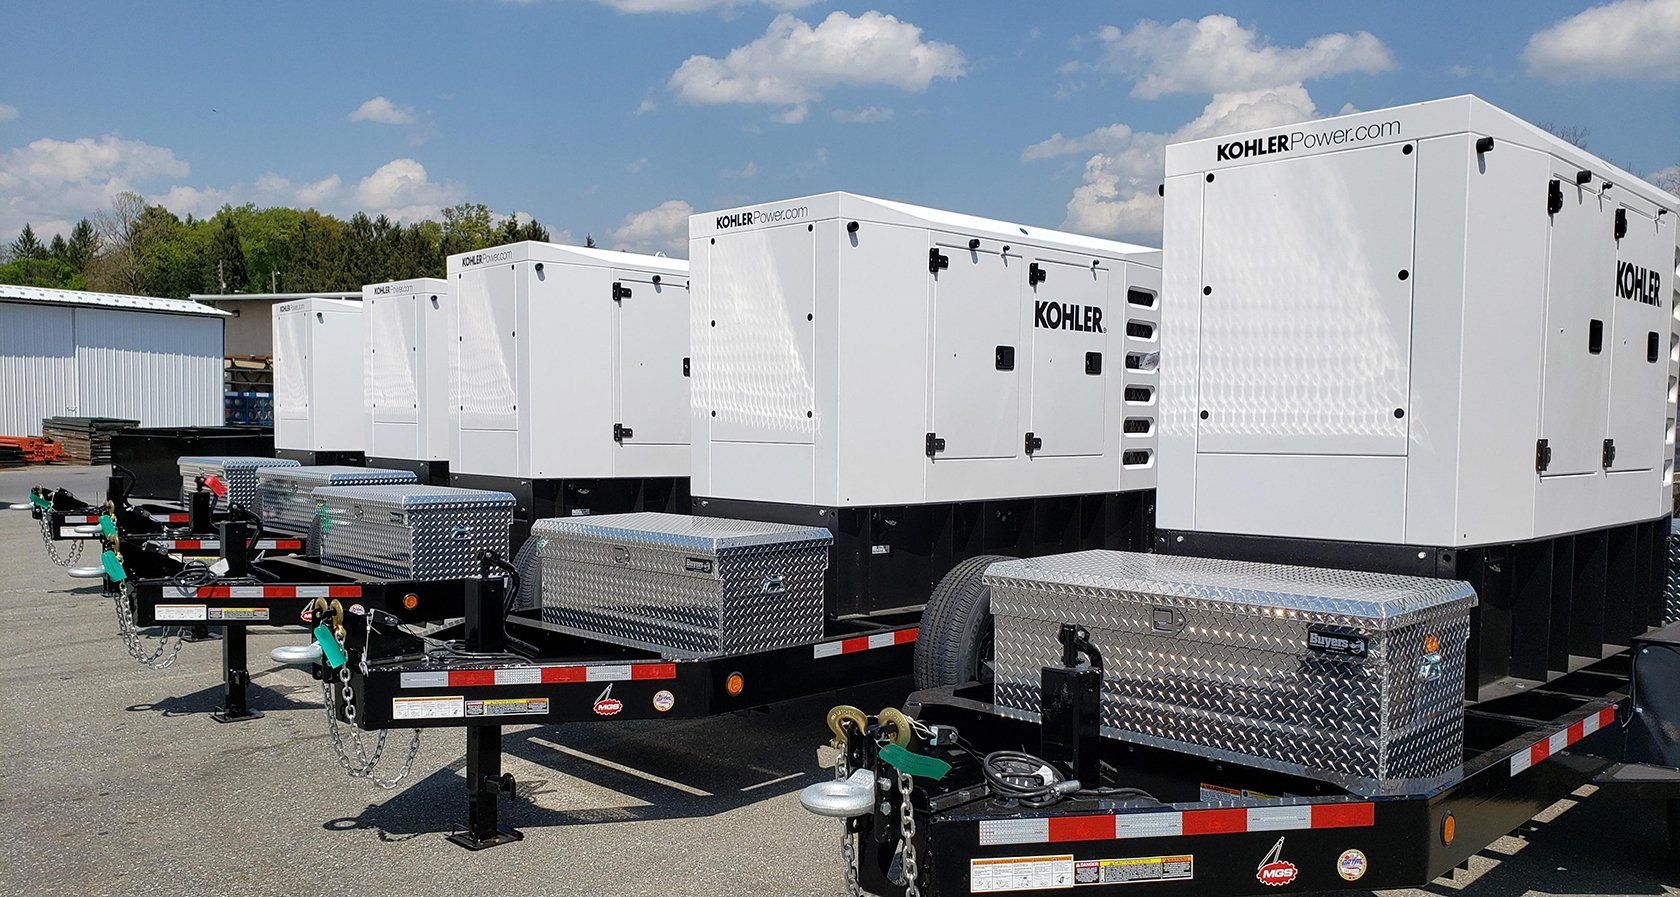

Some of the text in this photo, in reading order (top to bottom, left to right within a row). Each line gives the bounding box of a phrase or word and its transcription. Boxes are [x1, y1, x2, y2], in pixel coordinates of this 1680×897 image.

[1217, 120, 1401, 162] KOHLERPower.com
[716, 206, 808, 229] KOHLERPower.com
[1616, 260, 1661, 307] KOHLER
[1034, 300, 1104, 333] KOHLER
[1310, 632, 1349, 648] Buyers
[1263, 868, 1293, 878] MGS
